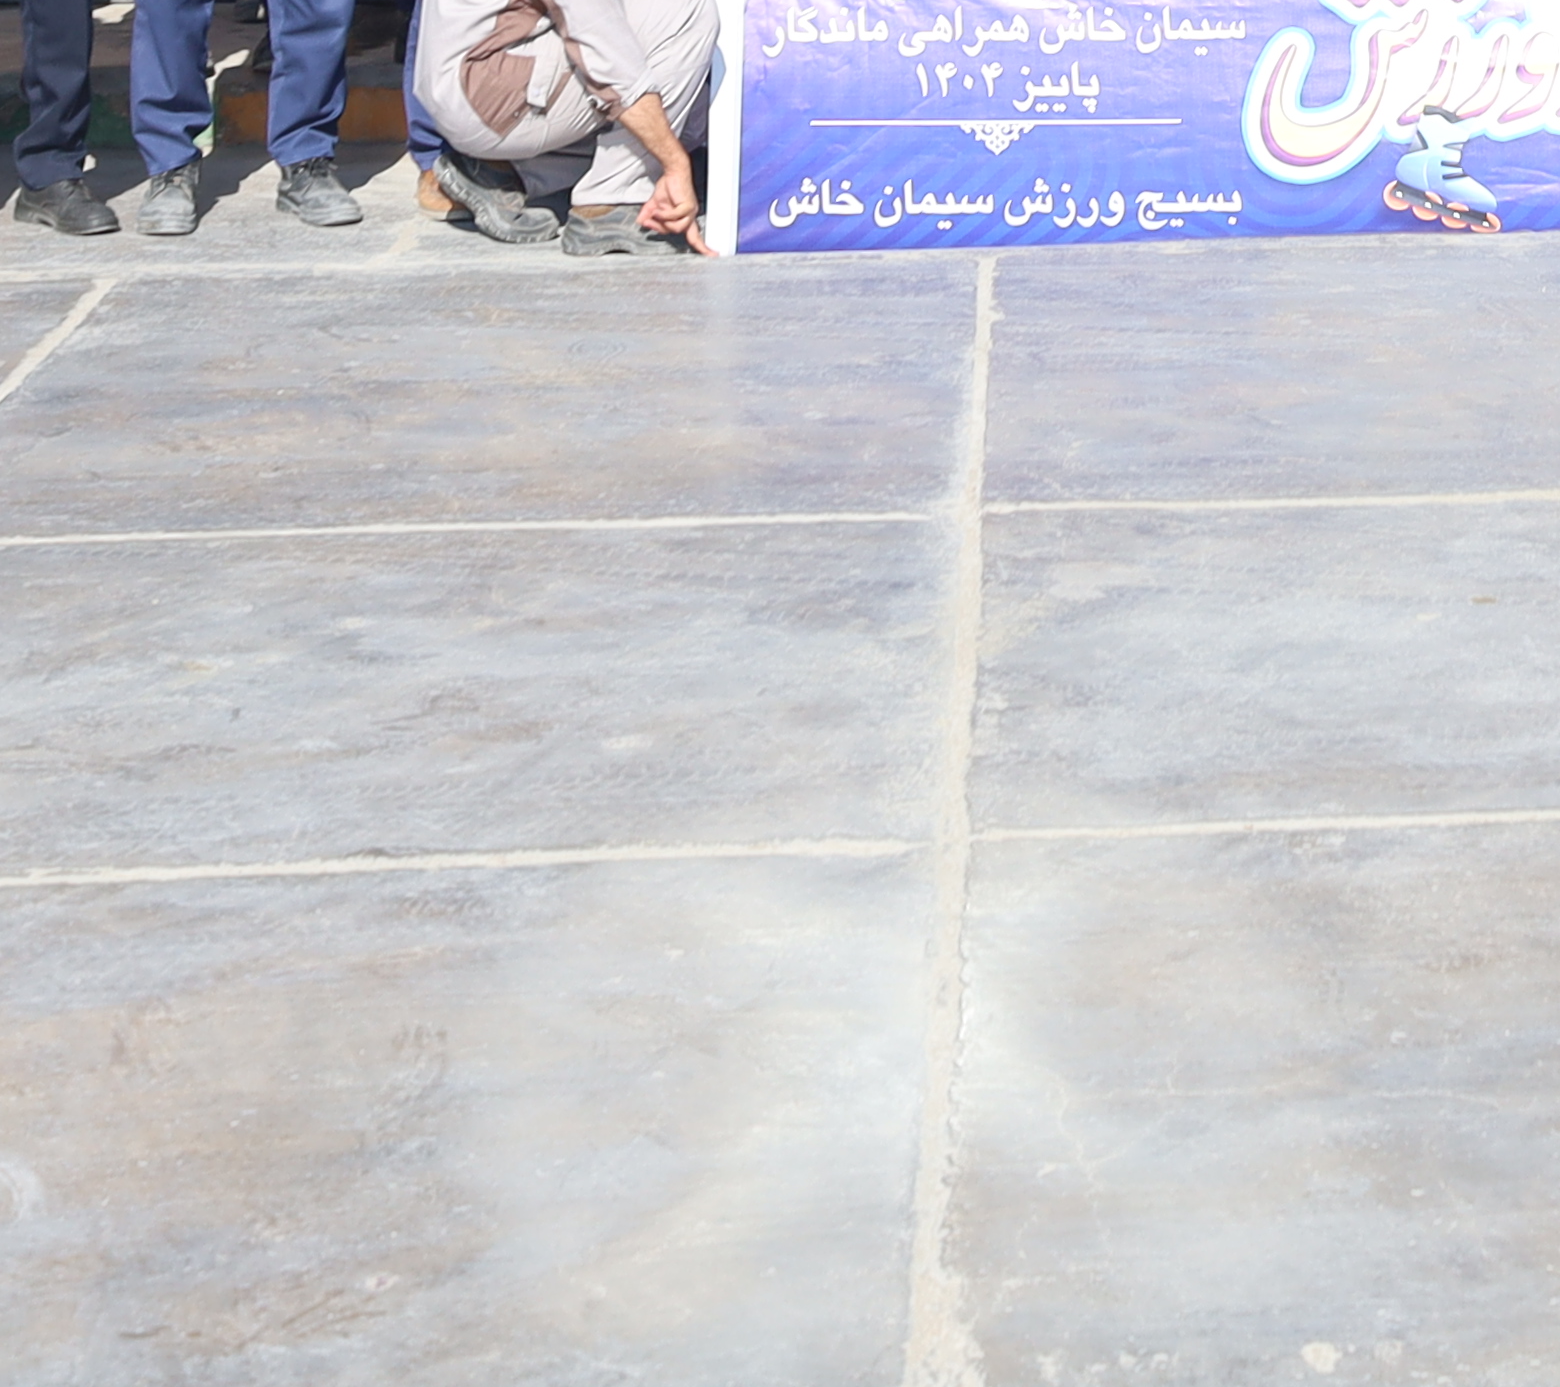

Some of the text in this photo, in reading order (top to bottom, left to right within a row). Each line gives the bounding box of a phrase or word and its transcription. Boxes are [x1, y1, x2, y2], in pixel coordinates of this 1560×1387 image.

[762, 6, 1246, 57] سیمان خاش همراهی ماندگار
[916, 61, 1100, 113] پاییز ۱۴۰۴
[768, 178, 1243, 230] بسیج ورزش سیمان خاش
